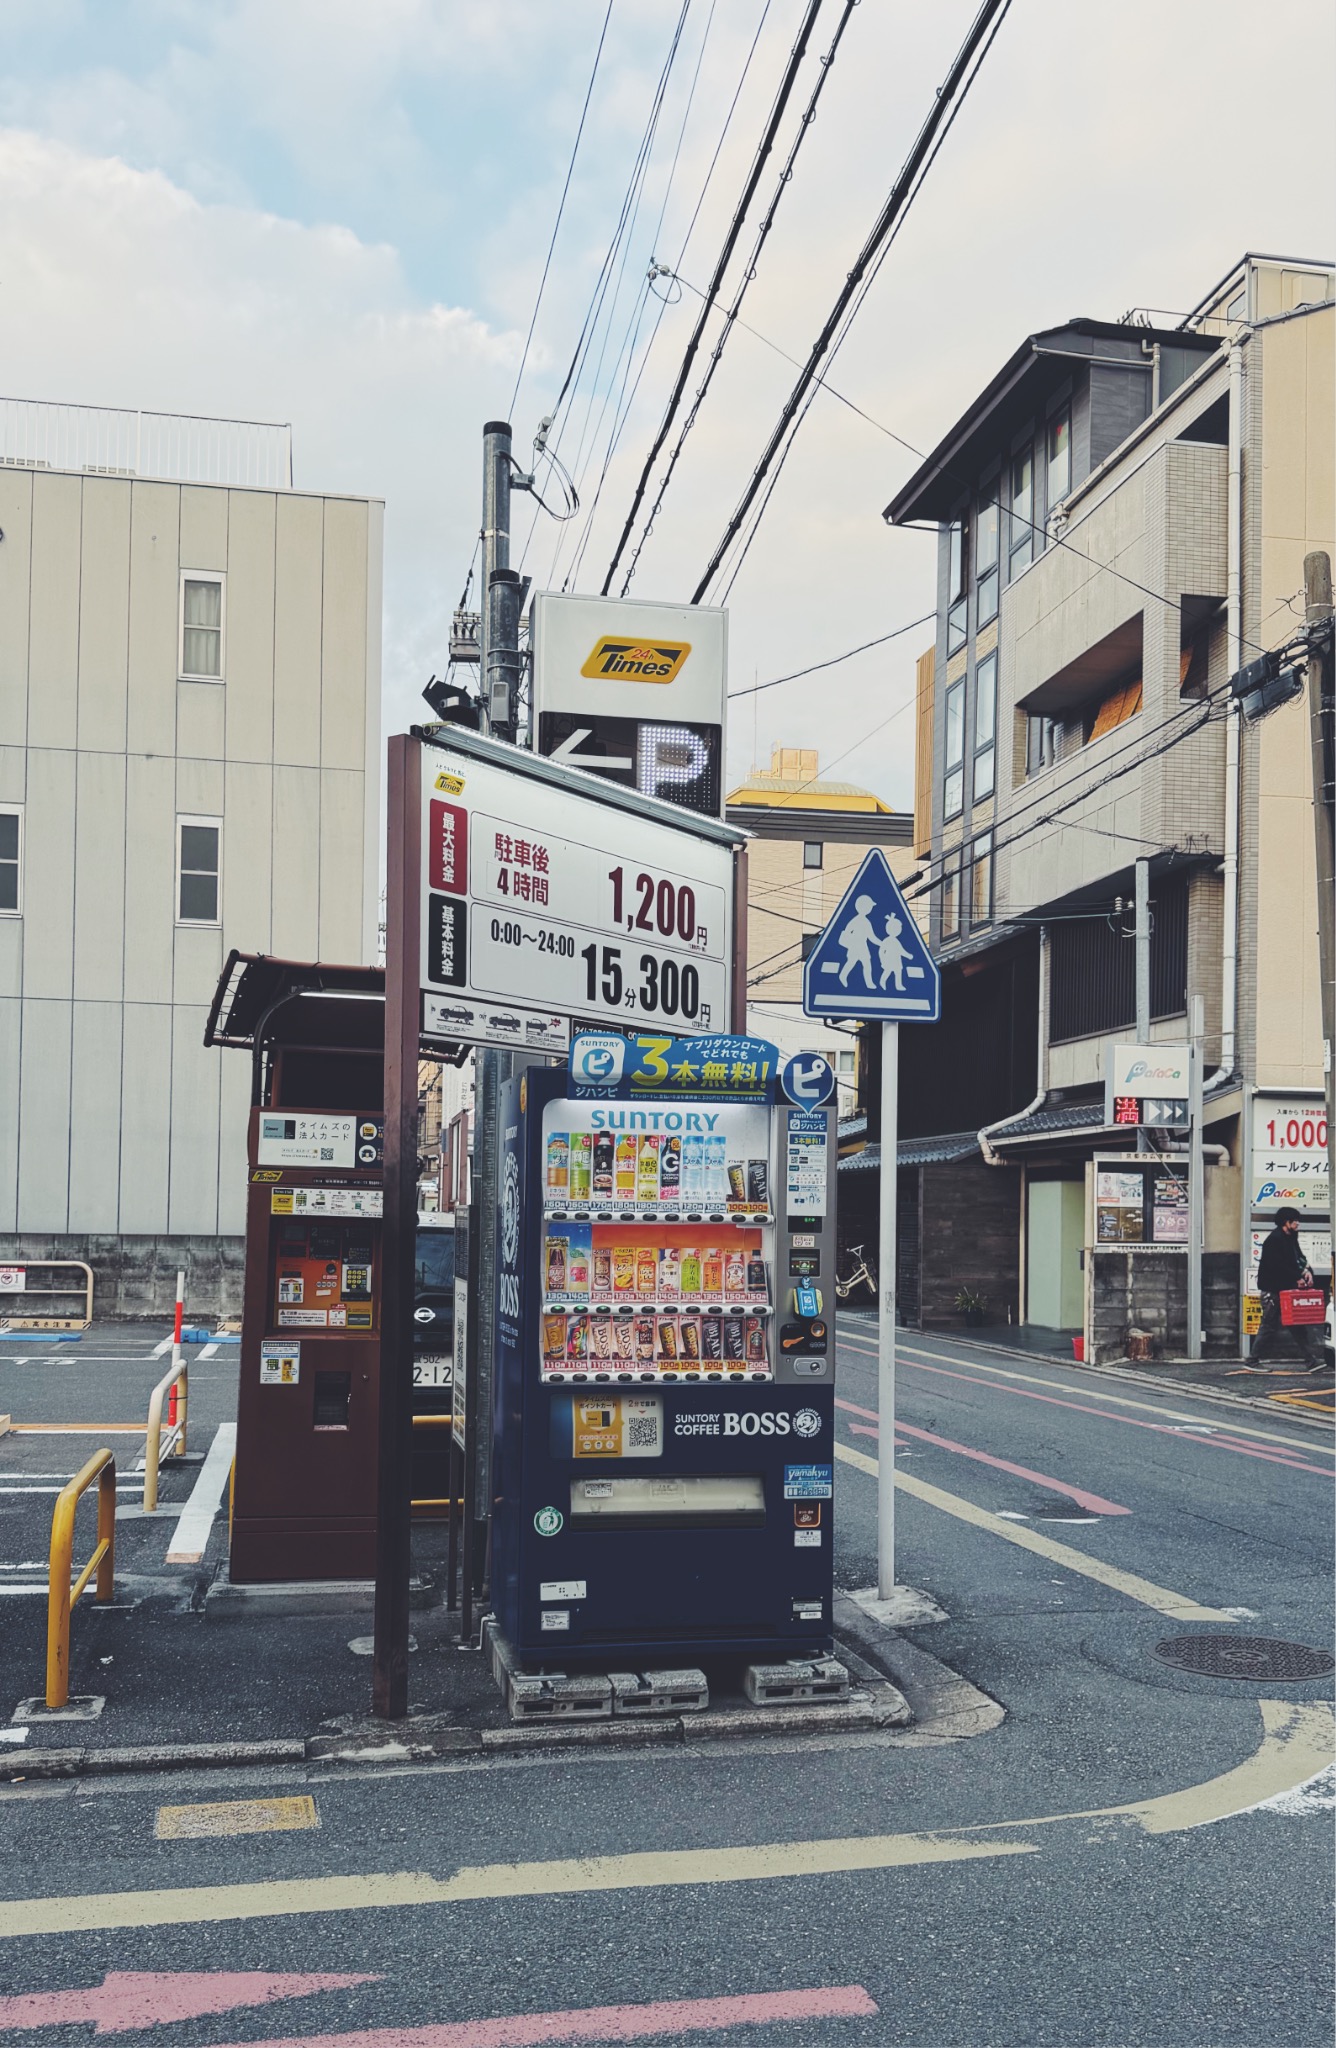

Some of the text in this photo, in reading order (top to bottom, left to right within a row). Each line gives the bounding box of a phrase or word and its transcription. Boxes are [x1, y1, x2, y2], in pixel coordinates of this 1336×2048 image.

[598, 648, 676, 676] Times
[640, 724, 709, 796] P
[443, 812, 455, 884] 最大料金
[494, 832, 550, 875] 駐車後
[441, 905, 454, 977] 基本料金
[684, 1039, 767, 1052] アプリダウンロード
[701, 1049, 749, 1059] でどれでも
[587, 1052, 611, 1075] ピ
[792, 1058, 826, 1098] ピ
[575, 1087, 618, 1098] ジハンピ
[299, 1121, 351, 1131] タイムズの
[591, 1109, 720, 1132] SUNTORY
[298, 1131, 350, 1141] 法人カード
[500, 1272, 519, 1318] BOSS
[675, 1413, 720, 1423] SUNTORY
[722, 1411, 791, 1436] BOSS
[674, 1424, 720, 1436] COFFEE
